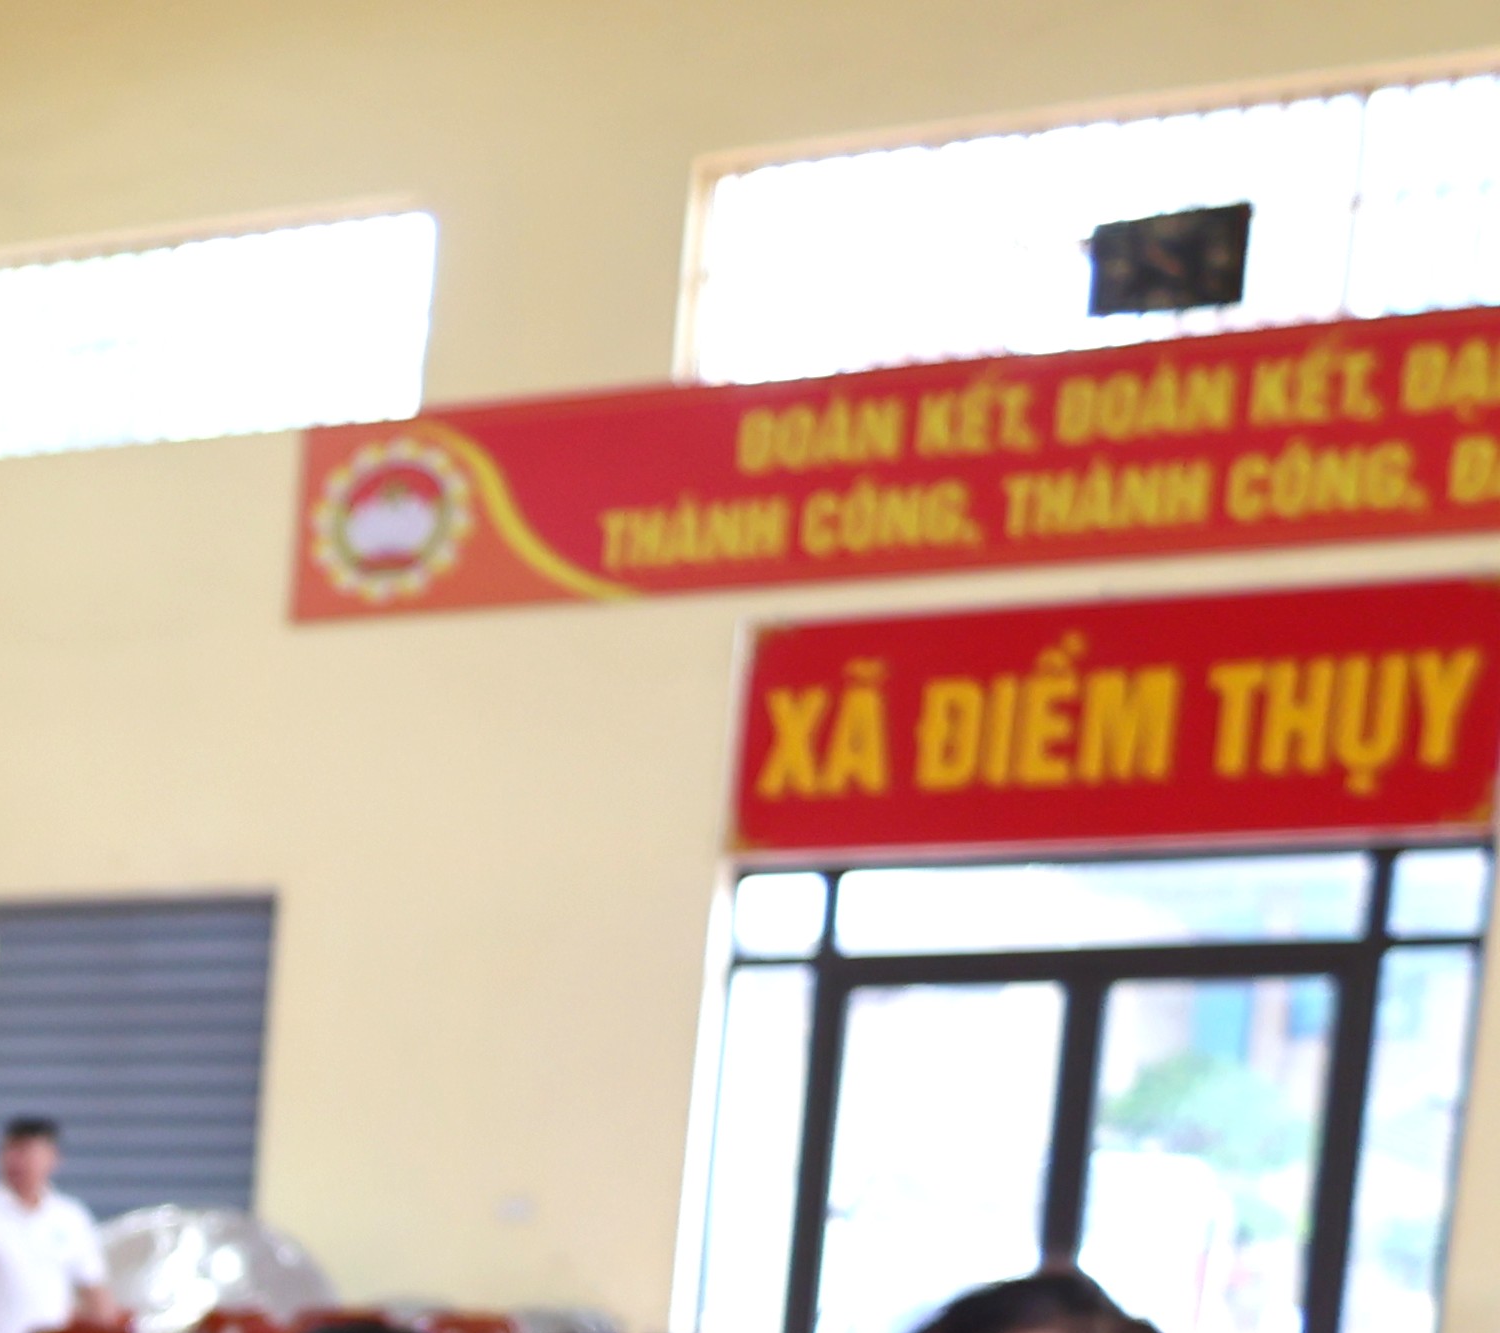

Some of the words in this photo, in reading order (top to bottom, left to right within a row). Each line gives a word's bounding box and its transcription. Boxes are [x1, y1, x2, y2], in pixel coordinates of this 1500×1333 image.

[736, 383, 904, 476] ĐOÀN
[1054, 355, 1237, 447] ĐOÀN
[1402, 337, 1500, 424] ĐẠ
[602, 487, 791, 571] THÀNH
[1004, 452, 1212, 540] THÀNH
[757, 655, 889, 797] XÃ
[915, 629, 1181, 792] ĐIỂM
[1207, 646, 1483, 797] THỤY
